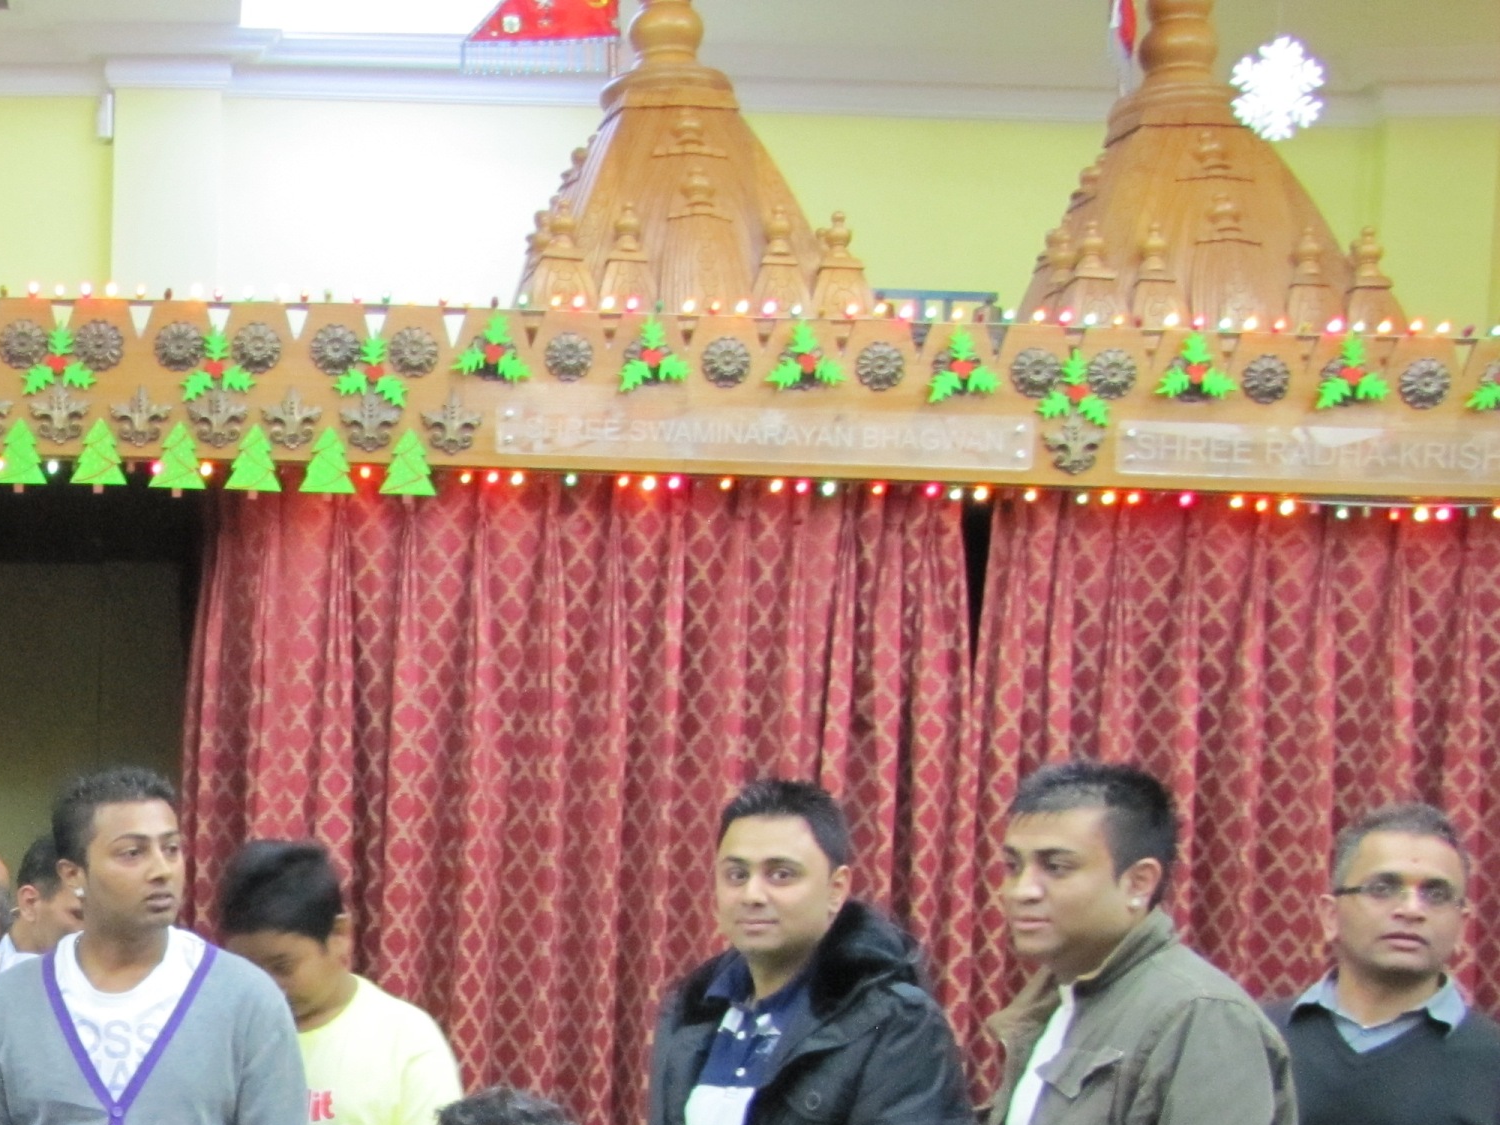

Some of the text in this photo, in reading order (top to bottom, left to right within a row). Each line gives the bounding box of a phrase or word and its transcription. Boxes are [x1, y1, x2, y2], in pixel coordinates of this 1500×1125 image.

[526, 416, 1004, 453] SHREE SWAMINARAYAN BHAGWAN
[1137, 433, 1252, 464] SHREE
